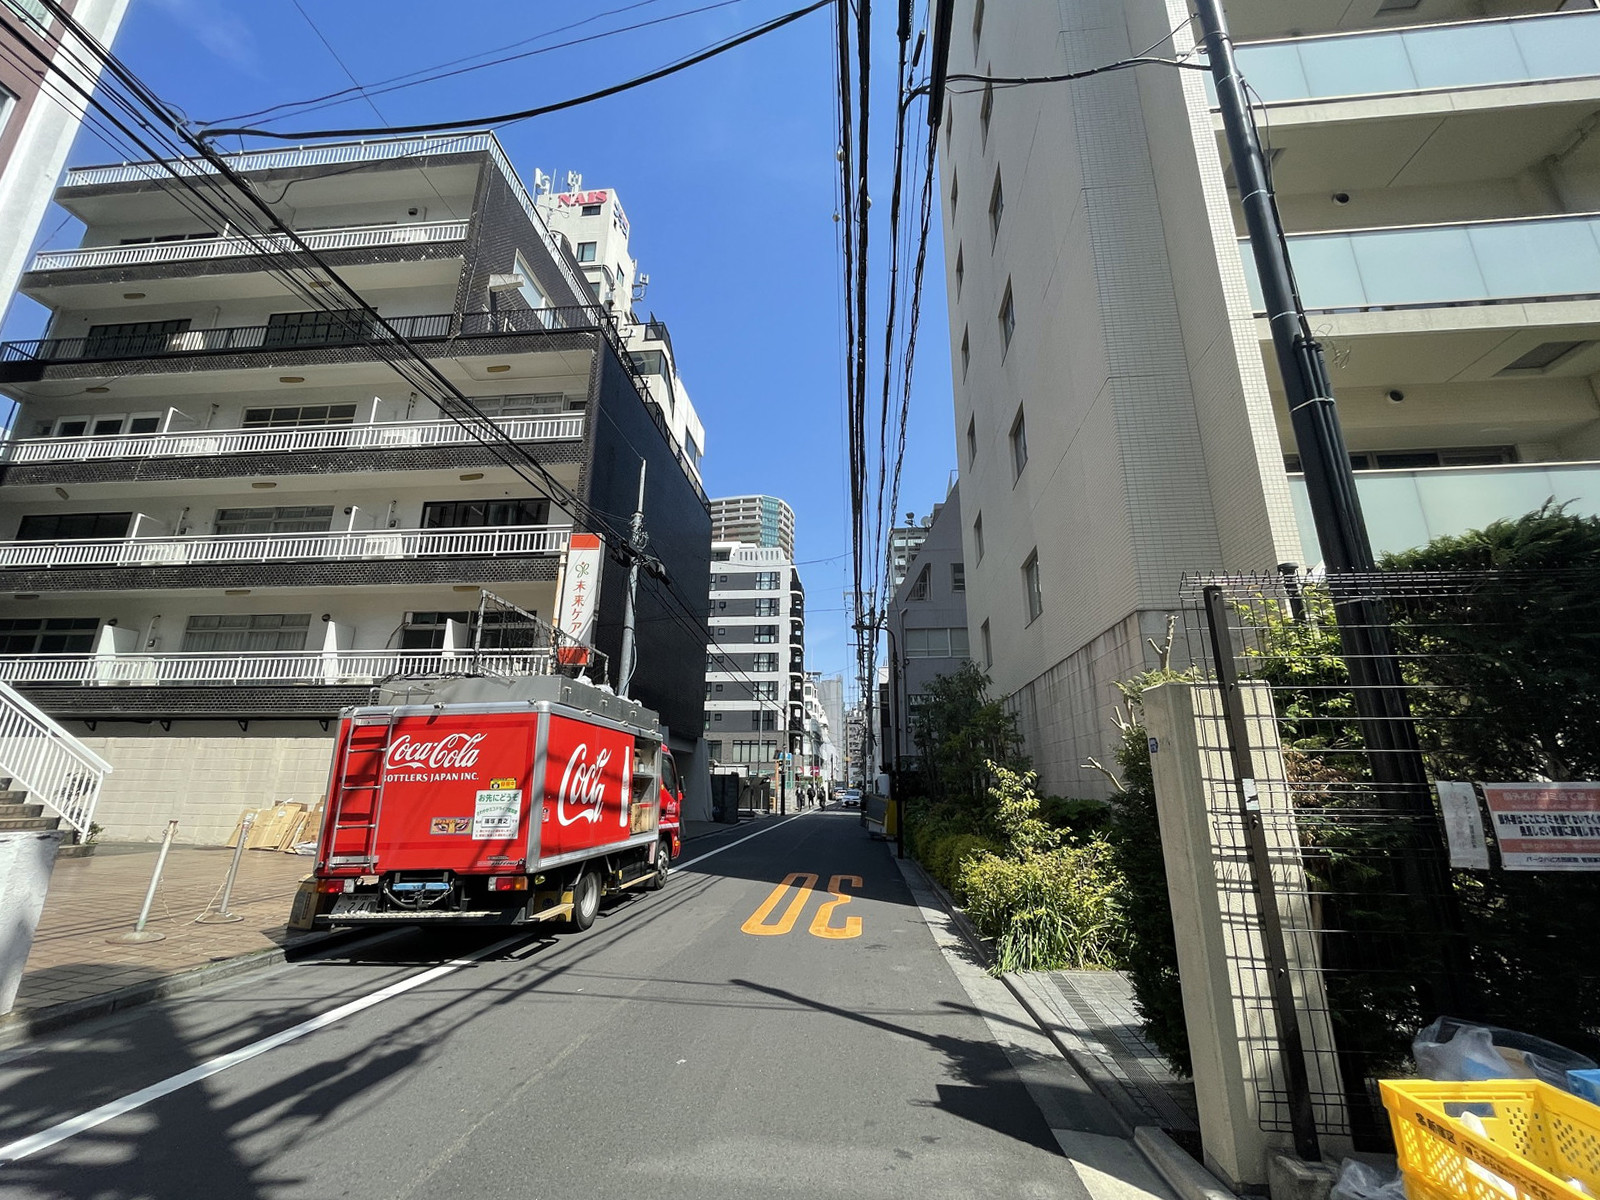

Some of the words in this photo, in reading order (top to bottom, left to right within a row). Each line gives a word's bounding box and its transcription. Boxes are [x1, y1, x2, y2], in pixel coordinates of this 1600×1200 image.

[557, 191, 608, 208] NAIS
[569, 580, 587, 635] 未来ケア
[383, 733, 488, 770] Coca-Cola
[430, 773, 459, 783] JAPAN
[460, 772, 479, 781] INC.
[478, 793, 519, 802] お先にどうぞ
